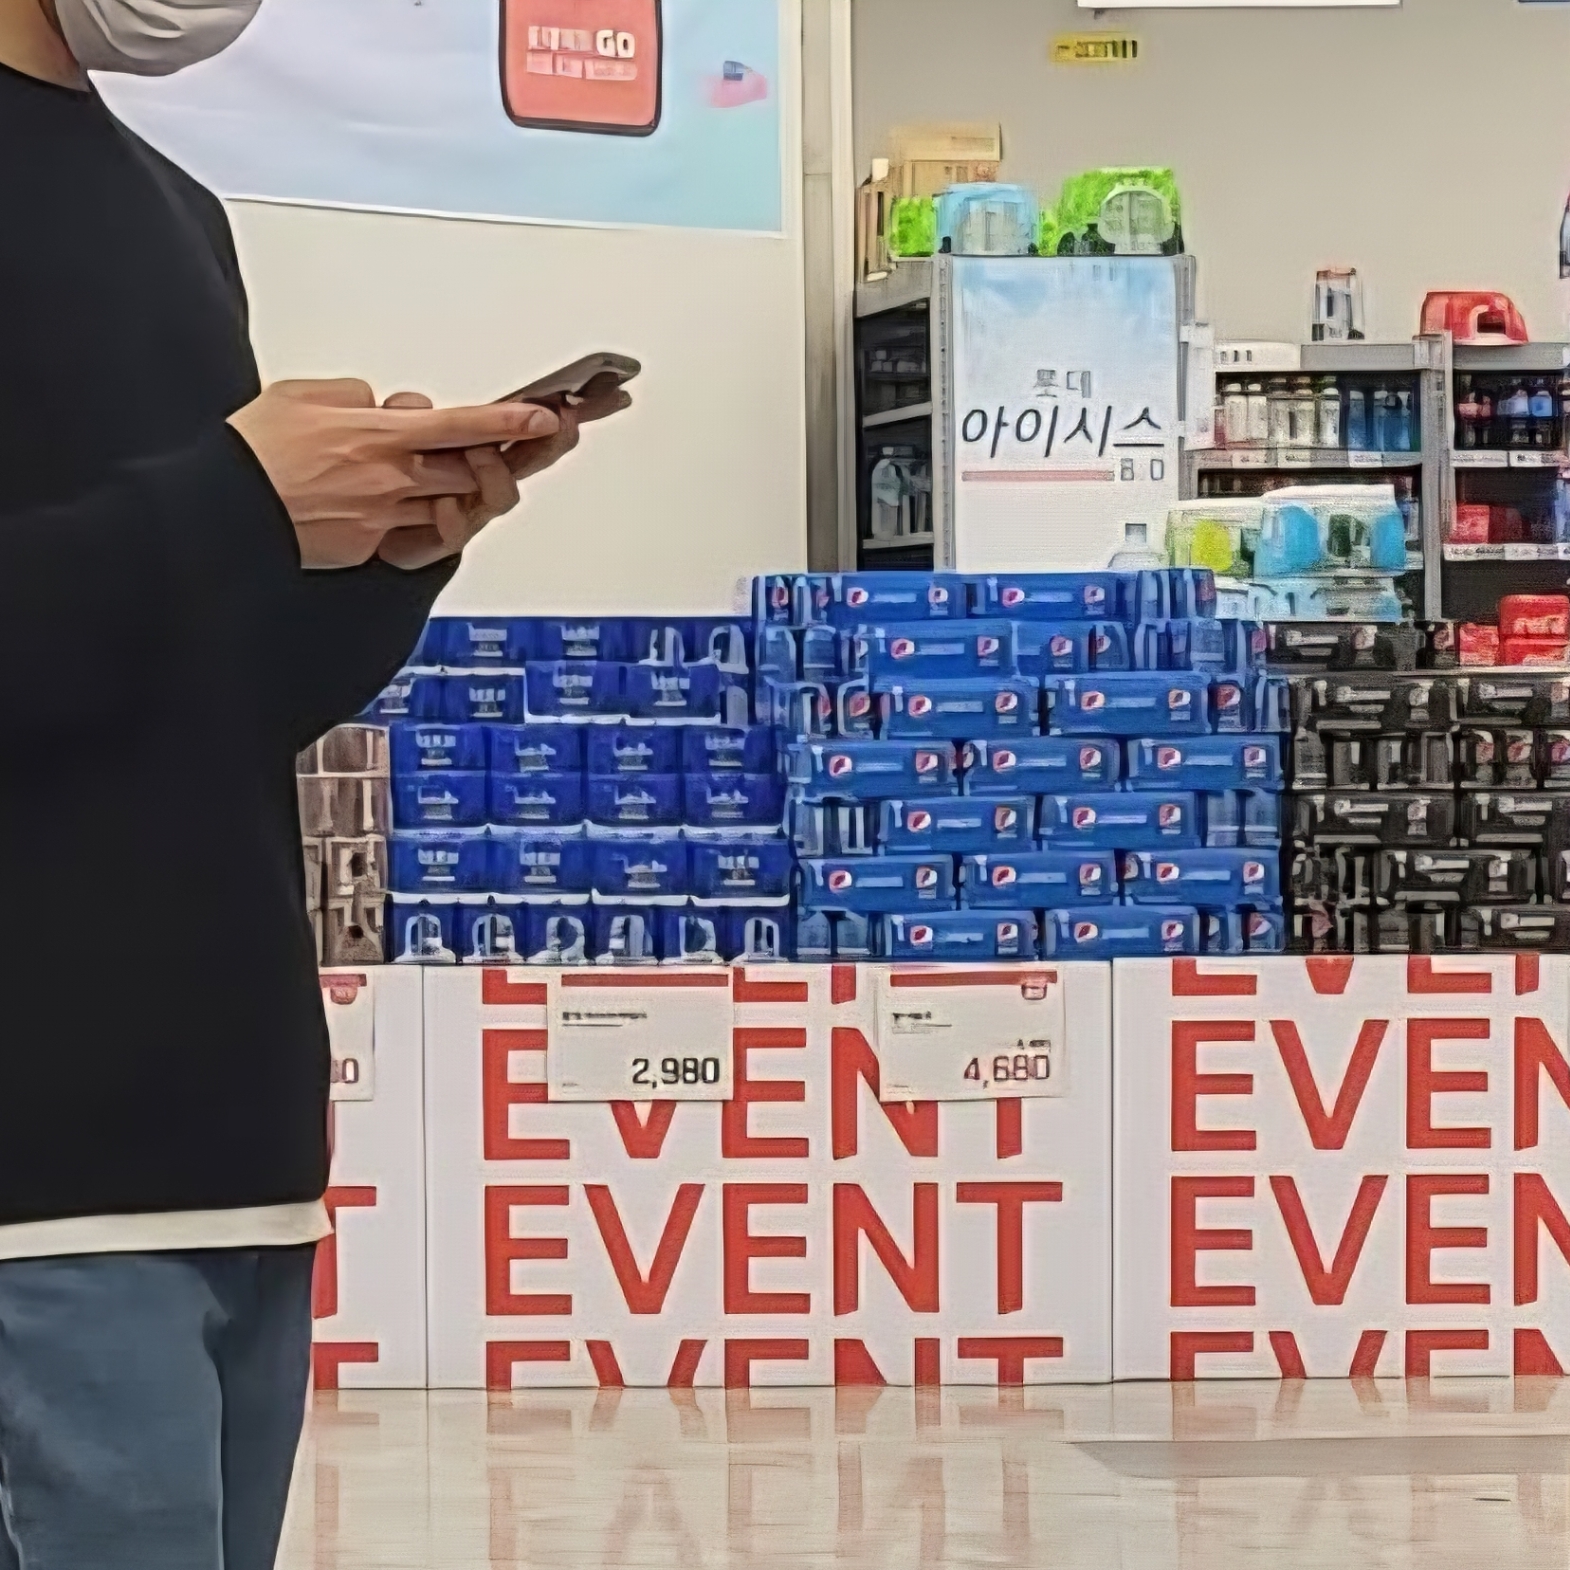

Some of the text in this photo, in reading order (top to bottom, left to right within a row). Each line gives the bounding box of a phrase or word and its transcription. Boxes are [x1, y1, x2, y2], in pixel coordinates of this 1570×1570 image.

[596, 29, 636, 59] GO
[962, 405, 1165, 459] 아이시스
[632, 1057, 720, 1089] 2,980
[964, 1055, 1050, 1089] 4,680
[484, 1182, 1063, 1316] EVENT
